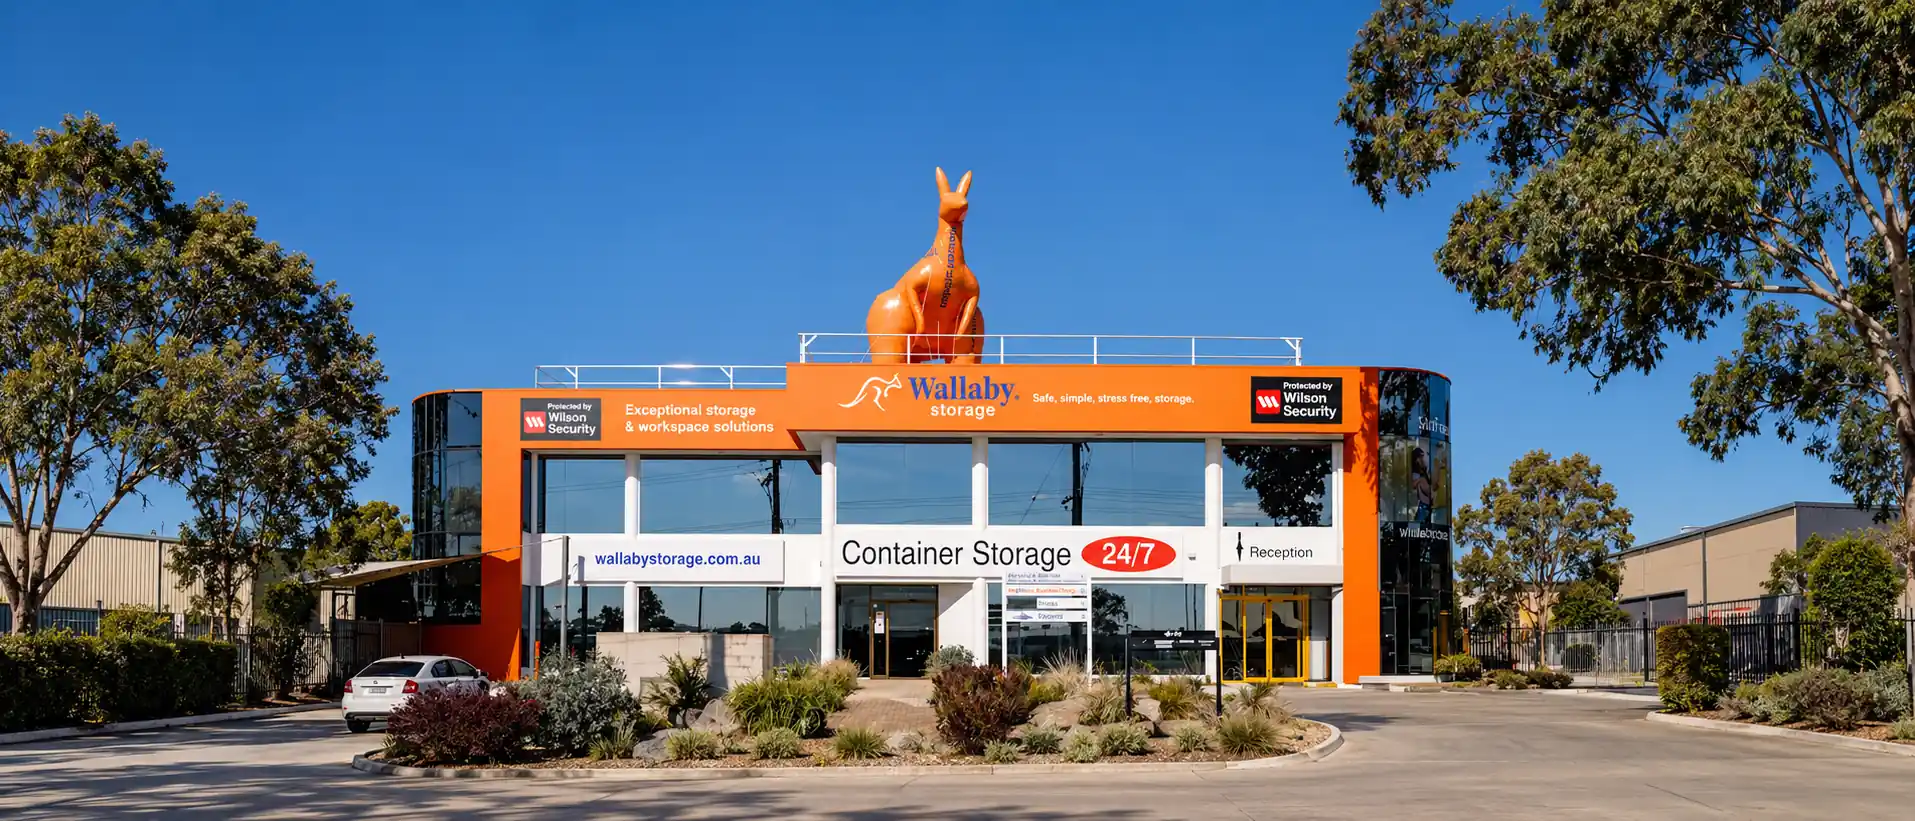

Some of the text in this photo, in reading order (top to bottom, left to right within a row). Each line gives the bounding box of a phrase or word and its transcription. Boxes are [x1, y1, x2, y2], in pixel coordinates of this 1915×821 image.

[1283, 381, 1333, 391] Protected by
[1032, 393, 1194, 405] Safe, simple, stress free, storage.
[1283, 391, 1327, 404] Wilson
[582, 402, 592, 412] by
[625, 403, 756, 419] Exceptional storage
[930, 404, 996, 420] storage
[1283, 404, 1337, 420] Security
[548, 411, 587, 423] Wilson
[548, 423, 596, 437] Security
[625, 420, 774, 434] & workspace solutions
[842, 539, 1071, 572] Container Storage
[1101, 541, 1156, 569] 24/7
[1250, 546, 1313, 561] Reception
[595, 552, 761, 570] wallabystorage.com.au
